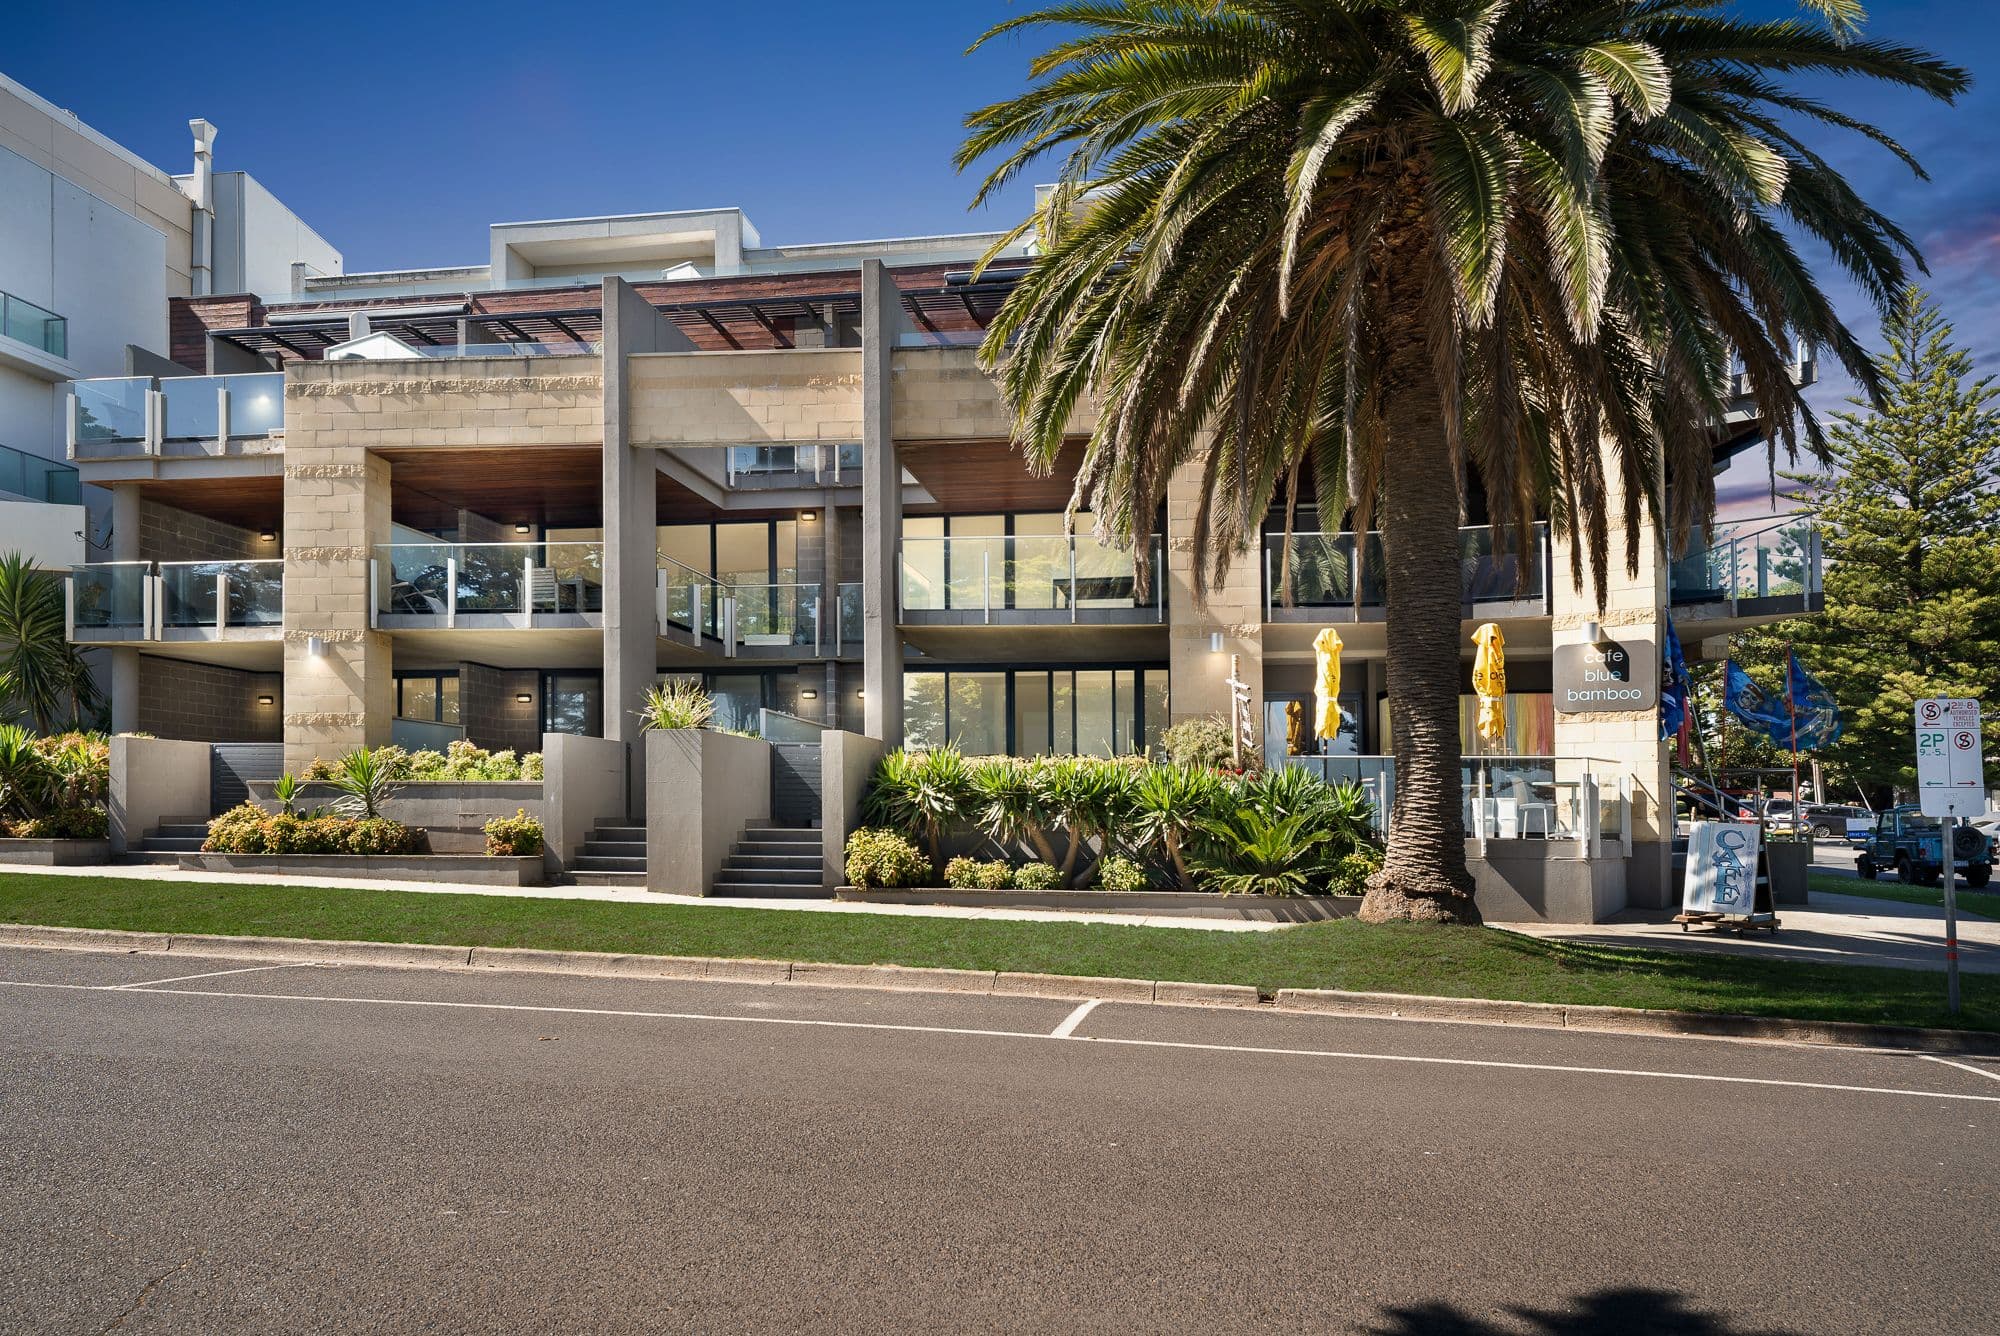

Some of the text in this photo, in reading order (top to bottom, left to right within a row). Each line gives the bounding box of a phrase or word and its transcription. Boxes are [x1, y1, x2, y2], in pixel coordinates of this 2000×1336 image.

[1584, 649, 1624, 664] cafe
[1584, 668, 1622, 682] blue
[1567, 687, 1642, 701] bamboo
[1919, 733, 1945, 748] 2P
[1712, 829, 1746, 906] CAFE
